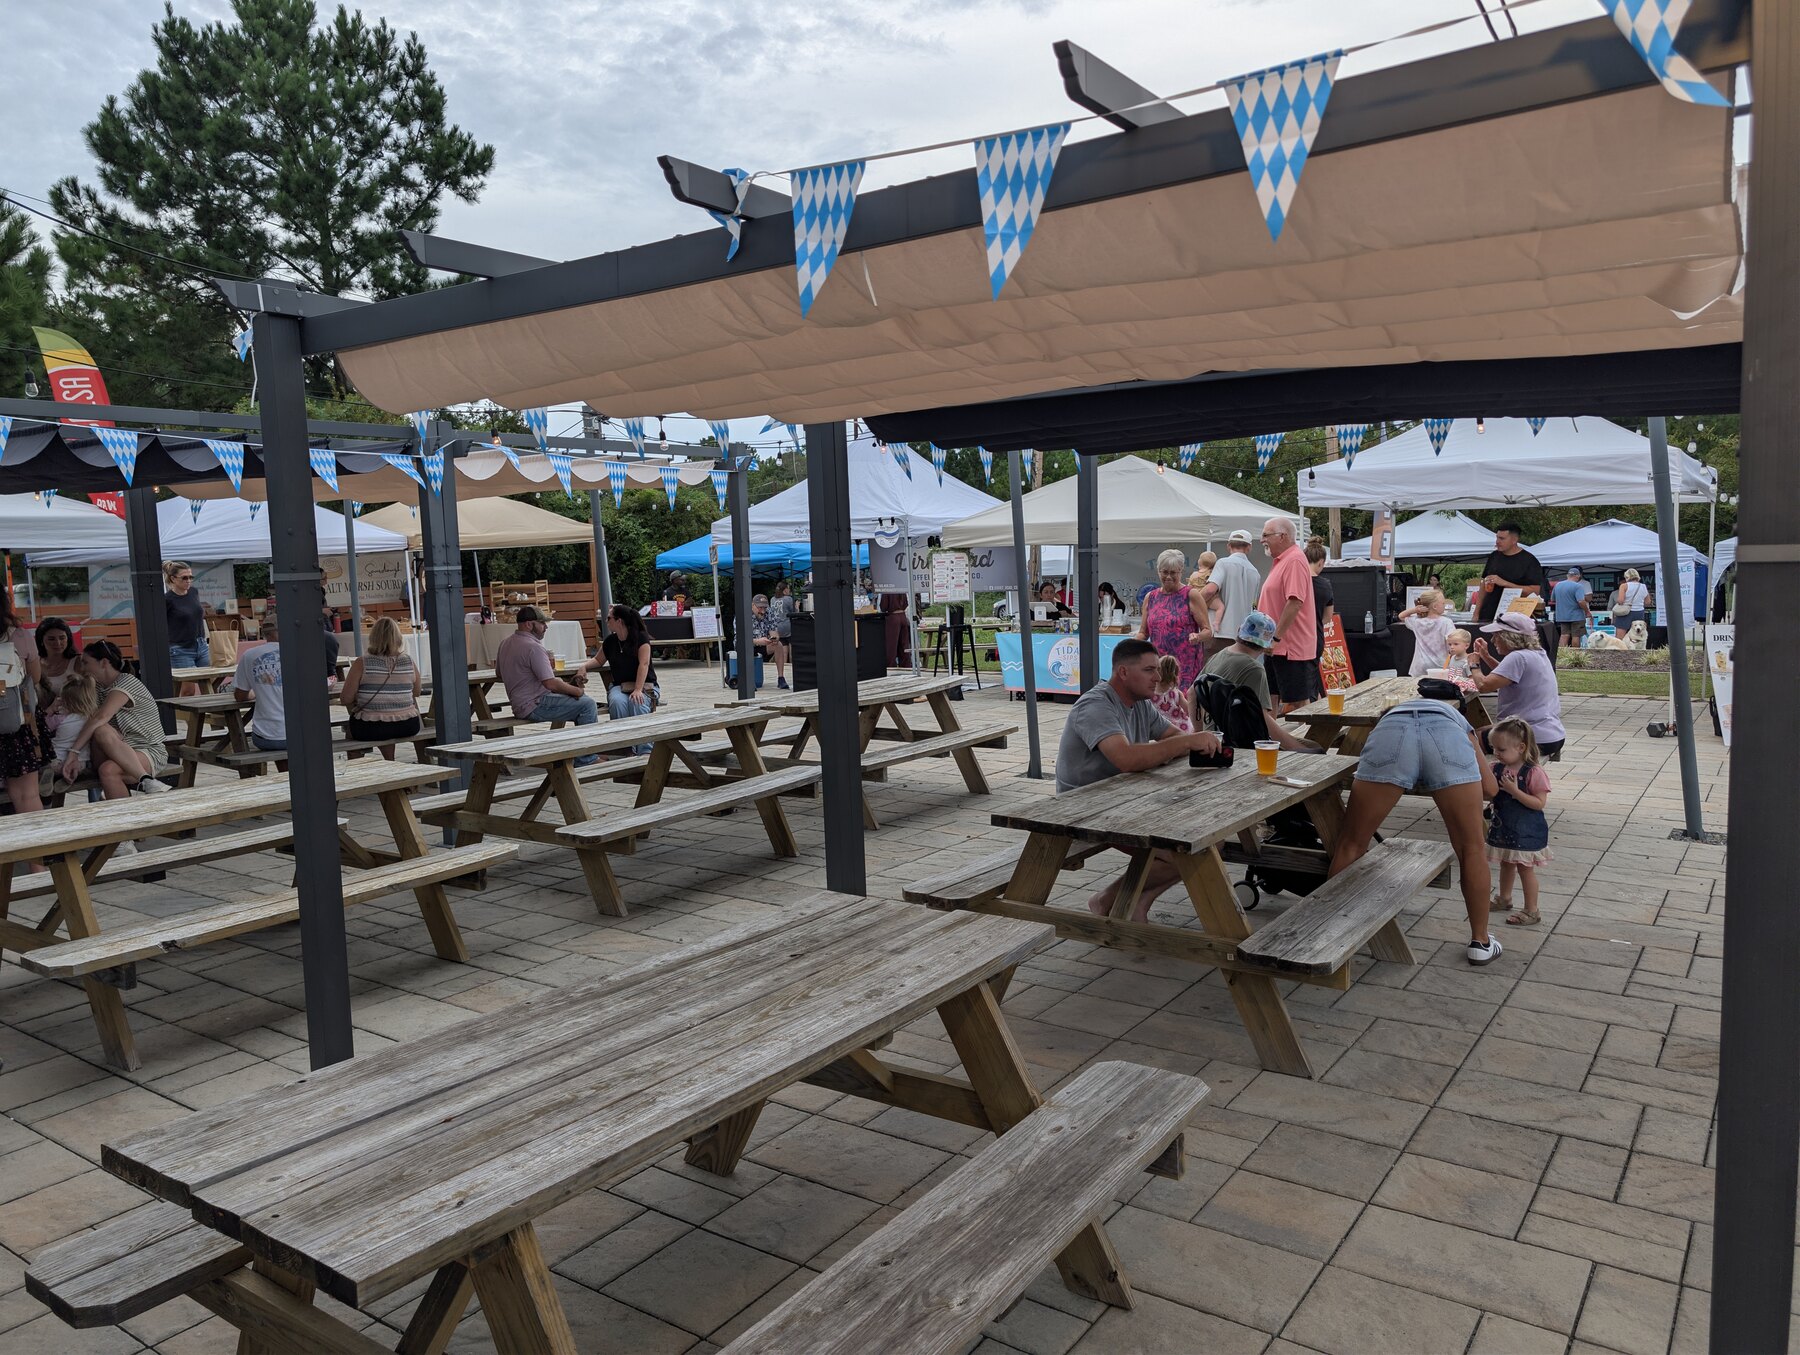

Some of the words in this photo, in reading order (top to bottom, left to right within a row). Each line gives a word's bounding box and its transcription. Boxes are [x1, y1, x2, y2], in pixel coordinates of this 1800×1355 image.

[325, 582, 343, 593] ALT
[344, 580, 374, 592] MRSH
[1056, 646, 1079, 655] TIDA
